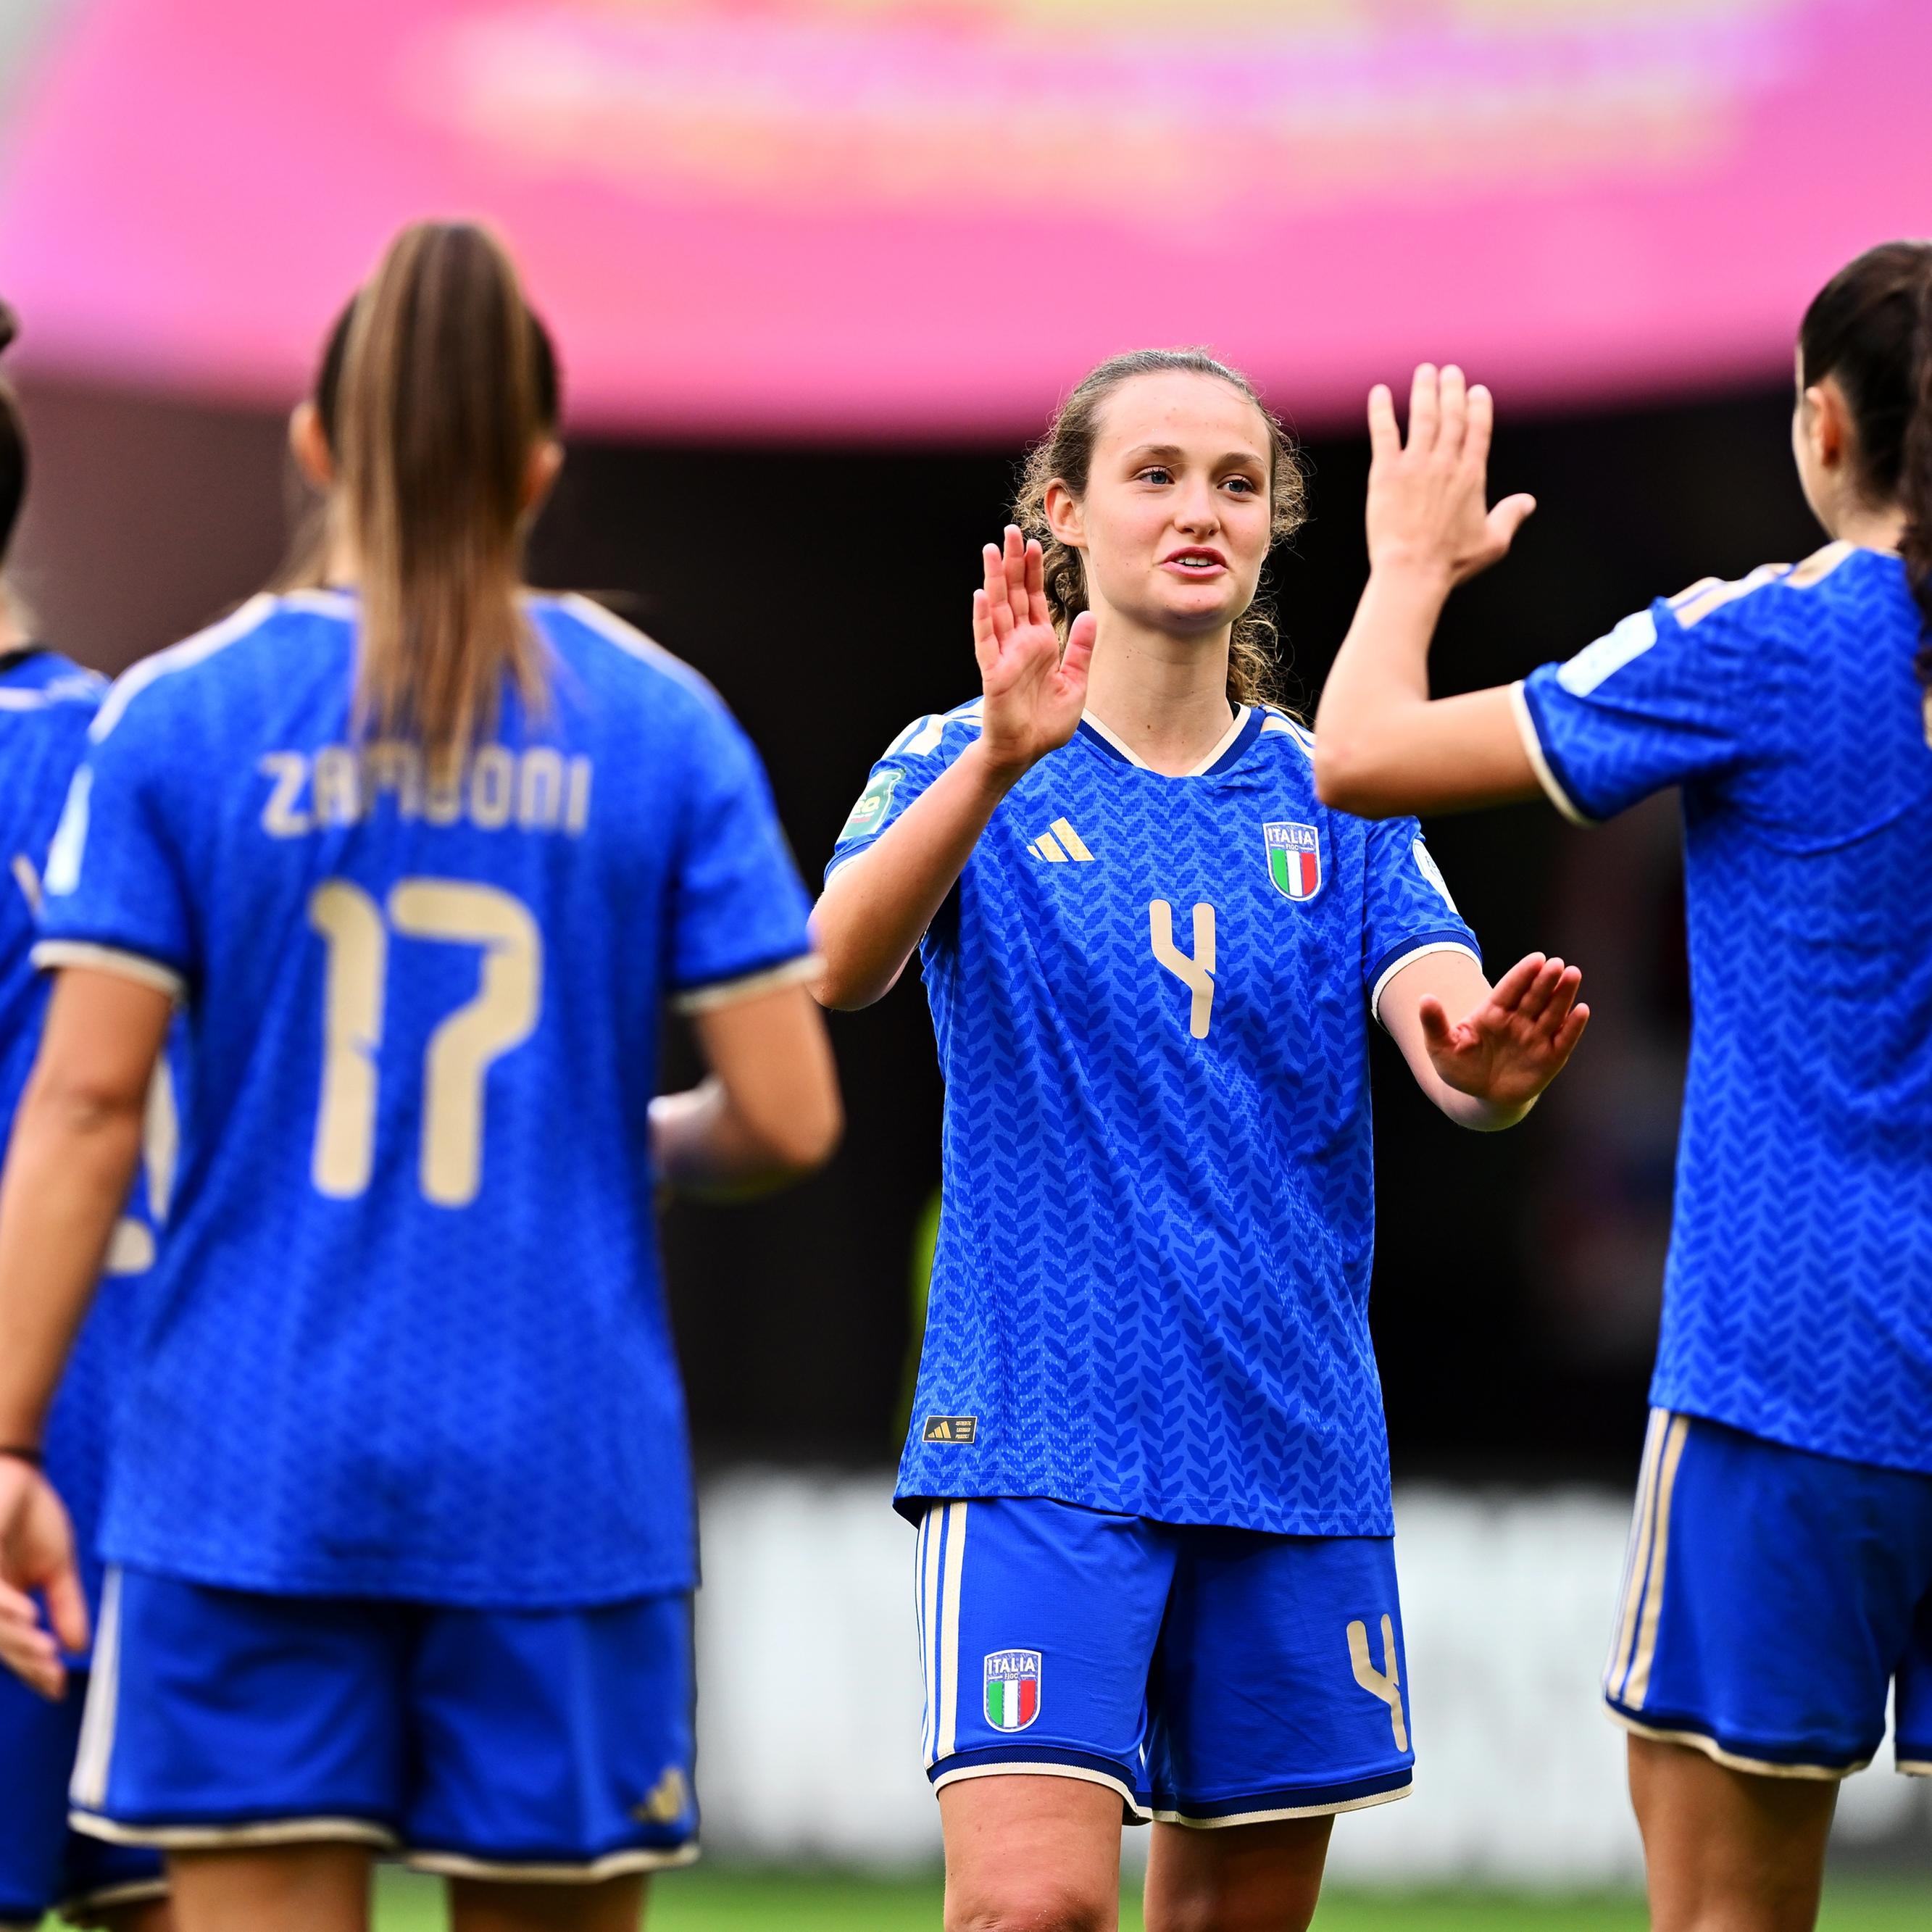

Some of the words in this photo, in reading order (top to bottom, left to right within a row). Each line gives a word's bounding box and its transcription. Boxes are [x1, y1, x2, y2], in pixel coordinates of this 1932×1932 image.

[1267, 827, 1314, 846] ITALIA
[1149, 899, 1216, 1039] 4
[308, 876, 543, 1209] 17
[988, 1657, 1036, 1675] ITALIA
[1346, 1613, 1408, 1753] 4
